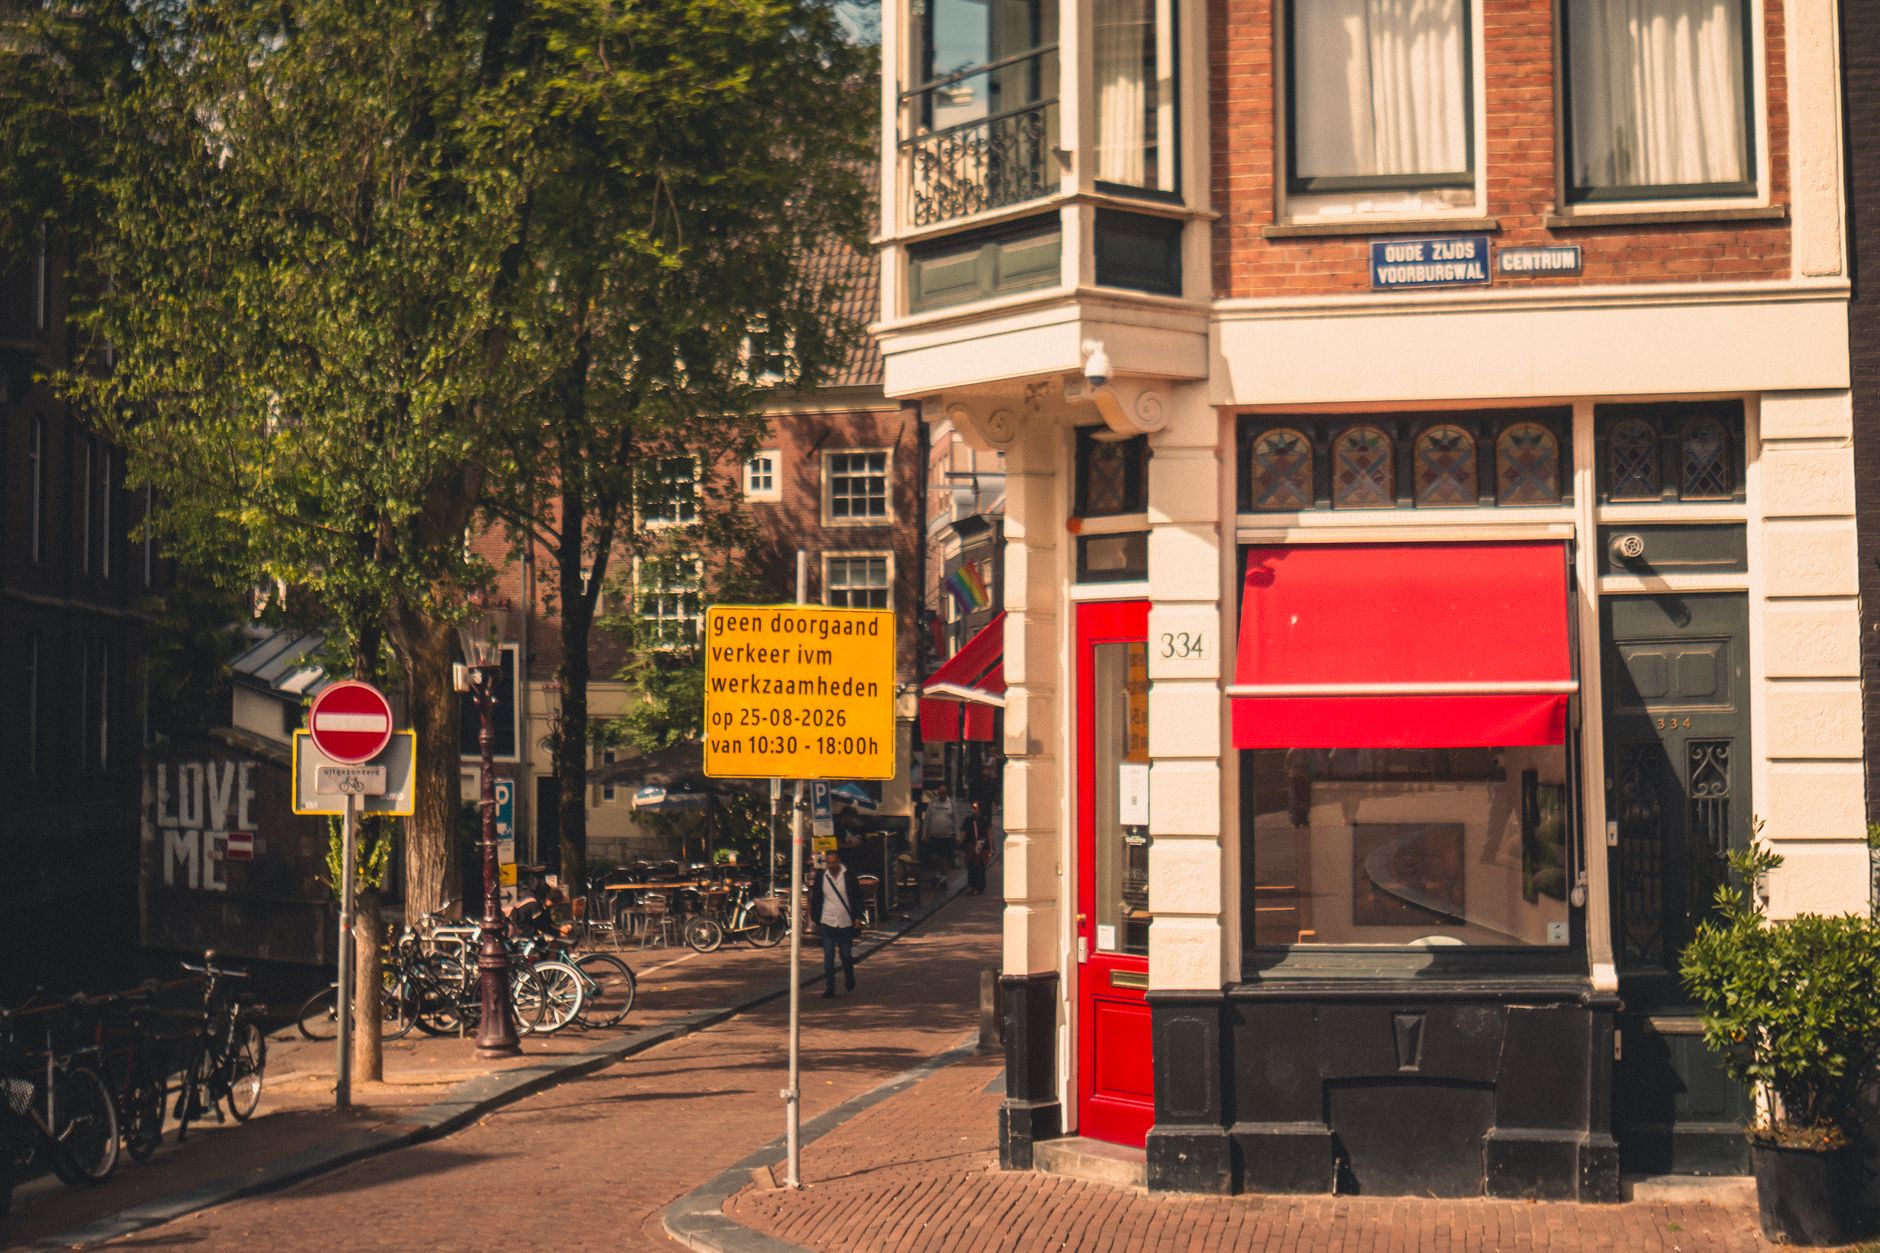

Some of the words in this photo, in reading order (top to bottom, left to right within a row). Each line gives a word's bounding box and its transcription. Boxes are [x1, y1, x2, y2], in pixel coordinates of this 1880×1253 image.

[1385, 245, 1424, 263] OUDE
[1432, 242, 1475, 260] ZIJDS
[1502, 252, 1575, 271] CENTRUM
[1377, 262, 1485, 284] VOORBURGWAL
[714, 615, 762, 637] geen
[771, 613, 879, 640] doorgaand
[712, 643, 790, 663] verkeer
[797, 643, 832, 665] ivm
[1160, 632, 1204, 659] 334
[711, 673, 878, 697] werkzaamheden
[712, 710, 733, 731] op
[740, 708, 847, 727] 25-08-2026
[1656, 717, 1693, 730] 334
[711, 739, 742, 753] van
[749, 736, 797, 754] 10:30
[817, 737, 878, 755] 18:00h
[157, 760, 259, 832] LOVE
[815, 783, 827, 804] P
[163, 829, 229, 892] ME
